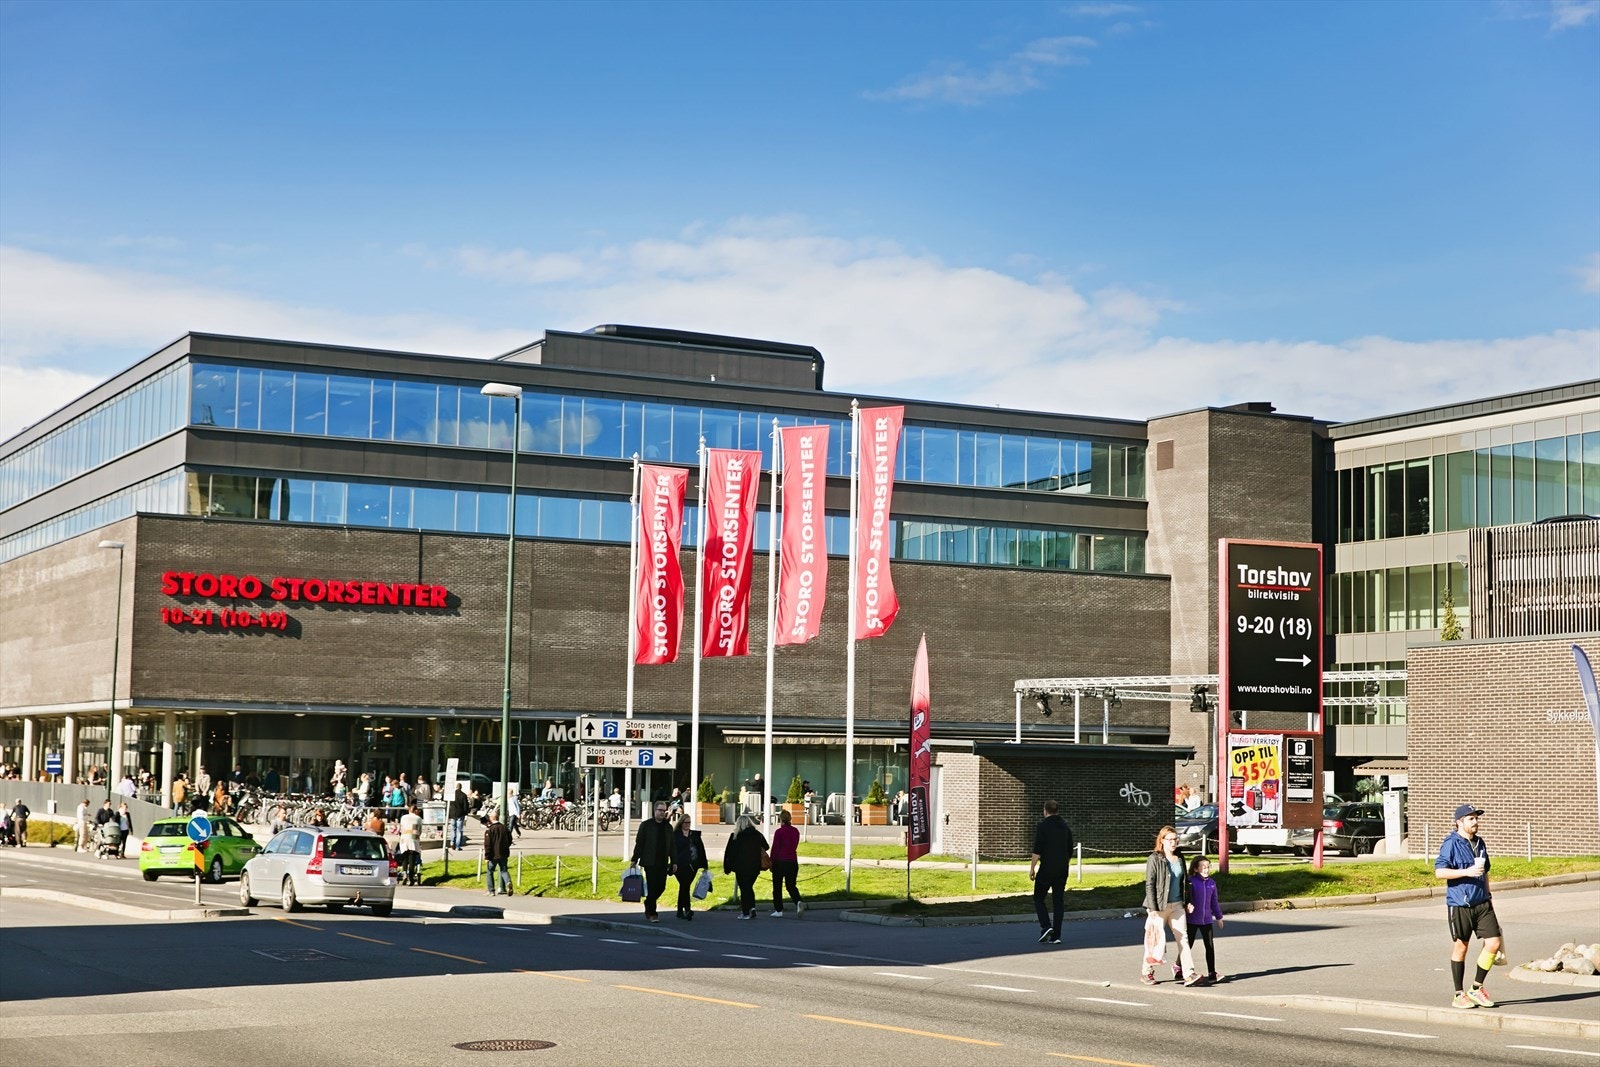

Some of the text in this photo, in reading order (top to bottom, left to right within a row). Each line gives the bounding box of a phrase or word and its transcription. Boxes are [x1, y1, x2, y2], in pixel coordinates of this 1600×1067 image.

[866, 416, 889, 629] STORO STORSENTER
[791, 435, 814, 637] STORO STORSENTER
[719, 458, 743, 648] STORO STORSENTER
[653, 474, 670, 657] STORO STORSENTER
[1237, 564, 1311, 587] Torshov
[161, 571, 448, 608] STORO STORSENTER
[1248, 589, 1300, 601] bilrekvisita
[161, 607, 288, 631] 10-21 (10-19)
[1237, 615, 1312, 640] 9-20 (18)
[1237, 685, 1312, 695] www.torshovbil.no
[626, 721, 671, 730] Storo senter
[1546, 709, 1591, 724] Sykkelpa
[586, 747, 606, 755] Storo
[612, 758, 633, 766] Ledige
[1234, 746, 1273, 764] OPP TIL
[1238, 759, 1276, 783] 35%
[911, 792, 920, 841] Torshov
